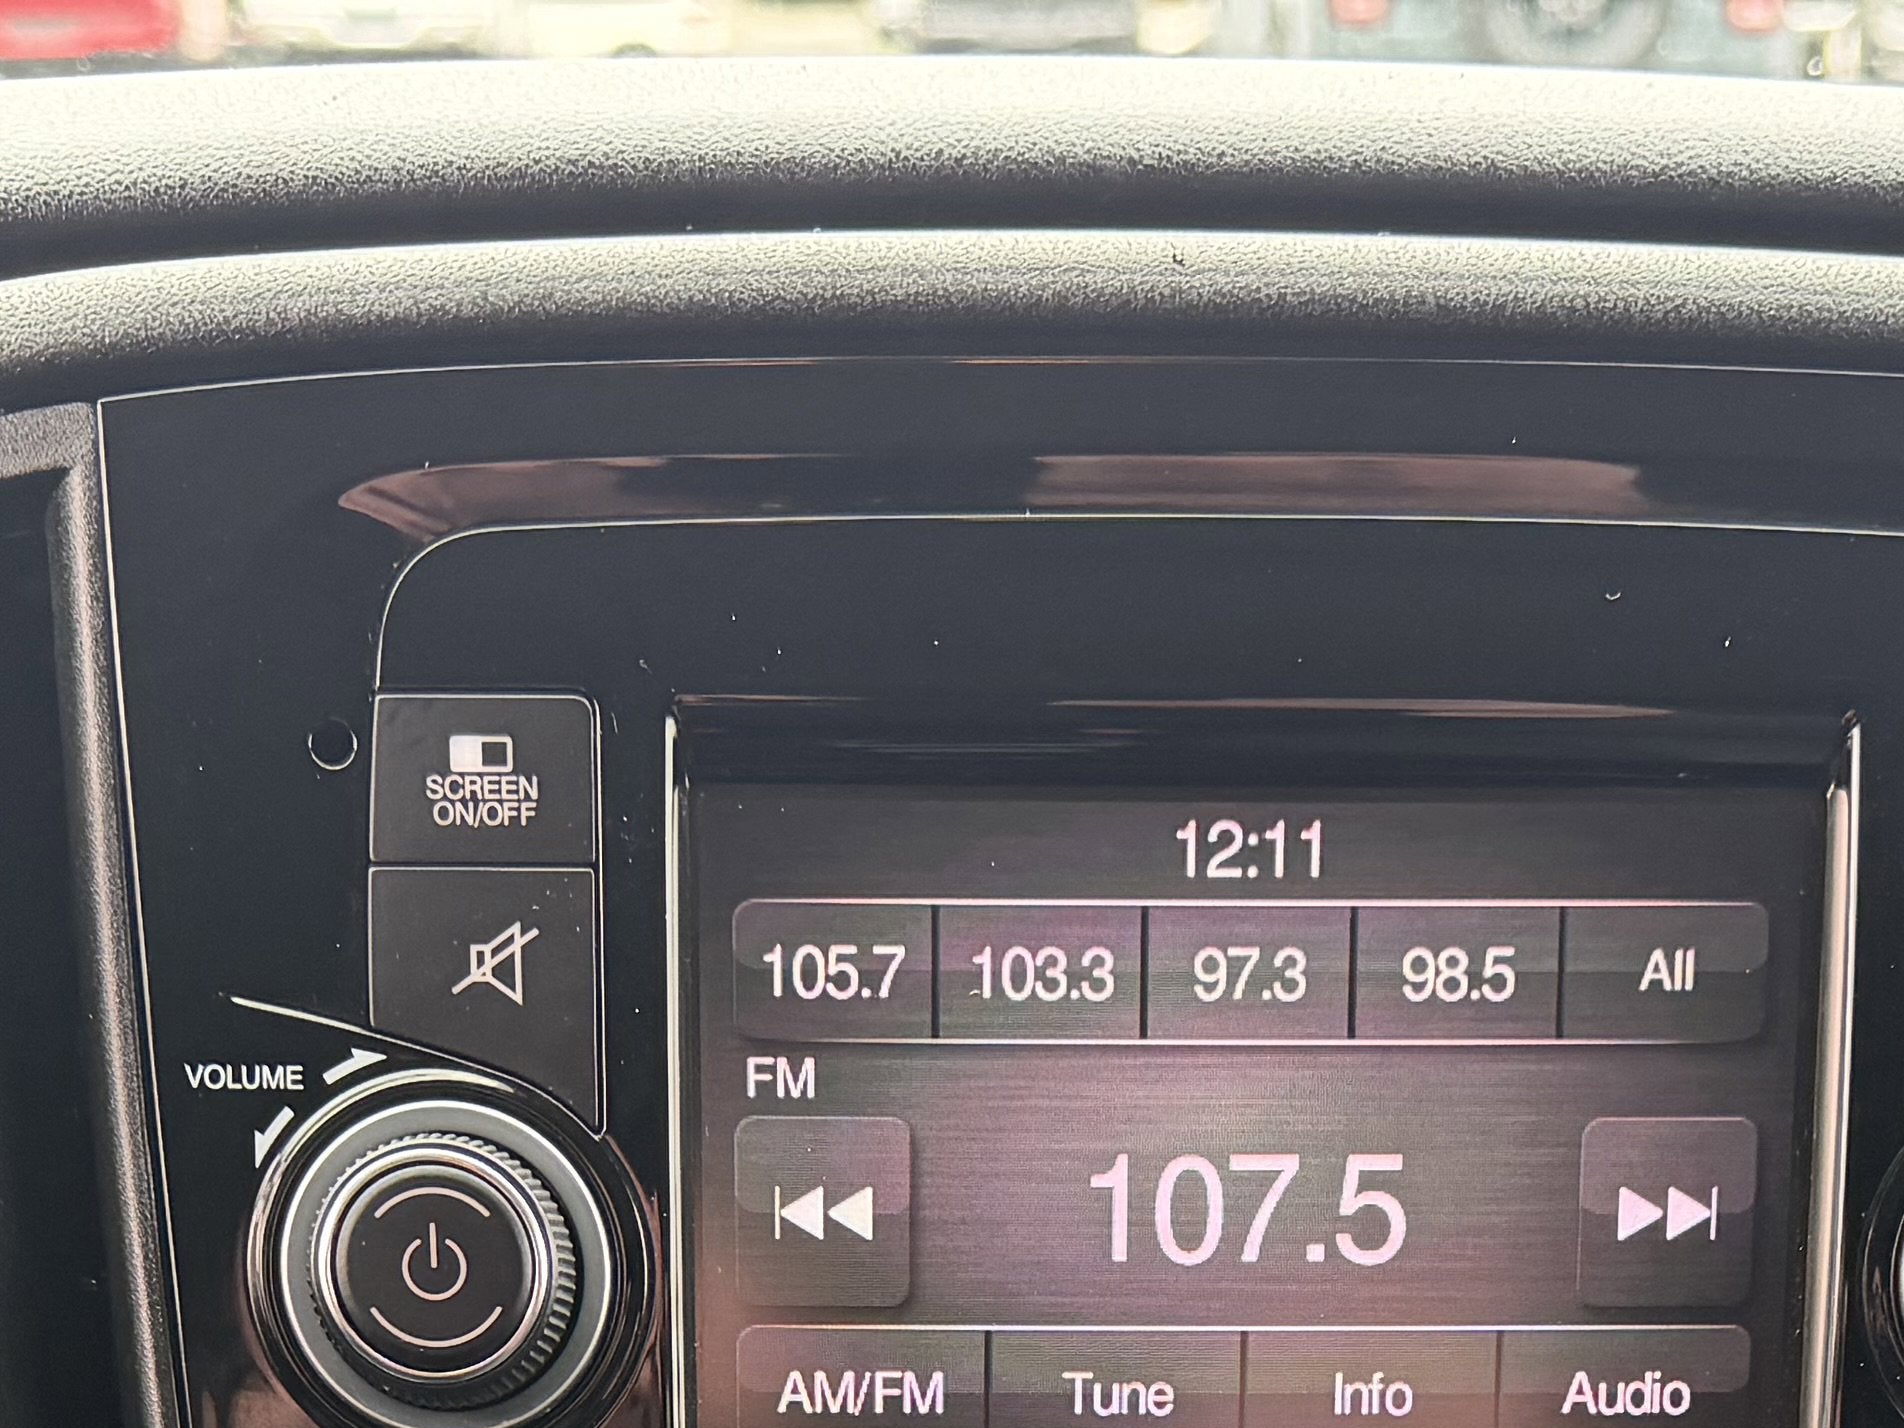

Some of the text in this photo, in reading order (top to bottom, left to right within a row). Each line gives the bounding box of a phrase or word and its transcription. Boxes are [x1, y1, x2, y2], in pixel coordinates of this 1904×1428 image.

[425, 774, 539, 801] SCREEN
[432, 801, 537, 828] ON/OFF
[1175, 818, 1323, 879] 12:11
[762, 943, 907, 1001] 105.7
[971, 945, 1115, 1002] 103.3
[1193, 946, 1307, 1003] 97.3
[1401, 946, 1516, 1003] 98.5
[1638, 948, 1696, 993] All
[183, 1063, 305, 1090] VOLUME
[746, 1056, 816, 1100] FM
[1089, 1153, 1408, 1267] 107.5
[776, 1369, 945, 1417] AM/FM
[1061, 1371, 1176, 1418] Tune
[1333, 1371, 1414, 1418] Info
[1560, 1369, 1692, 1417] Audio
